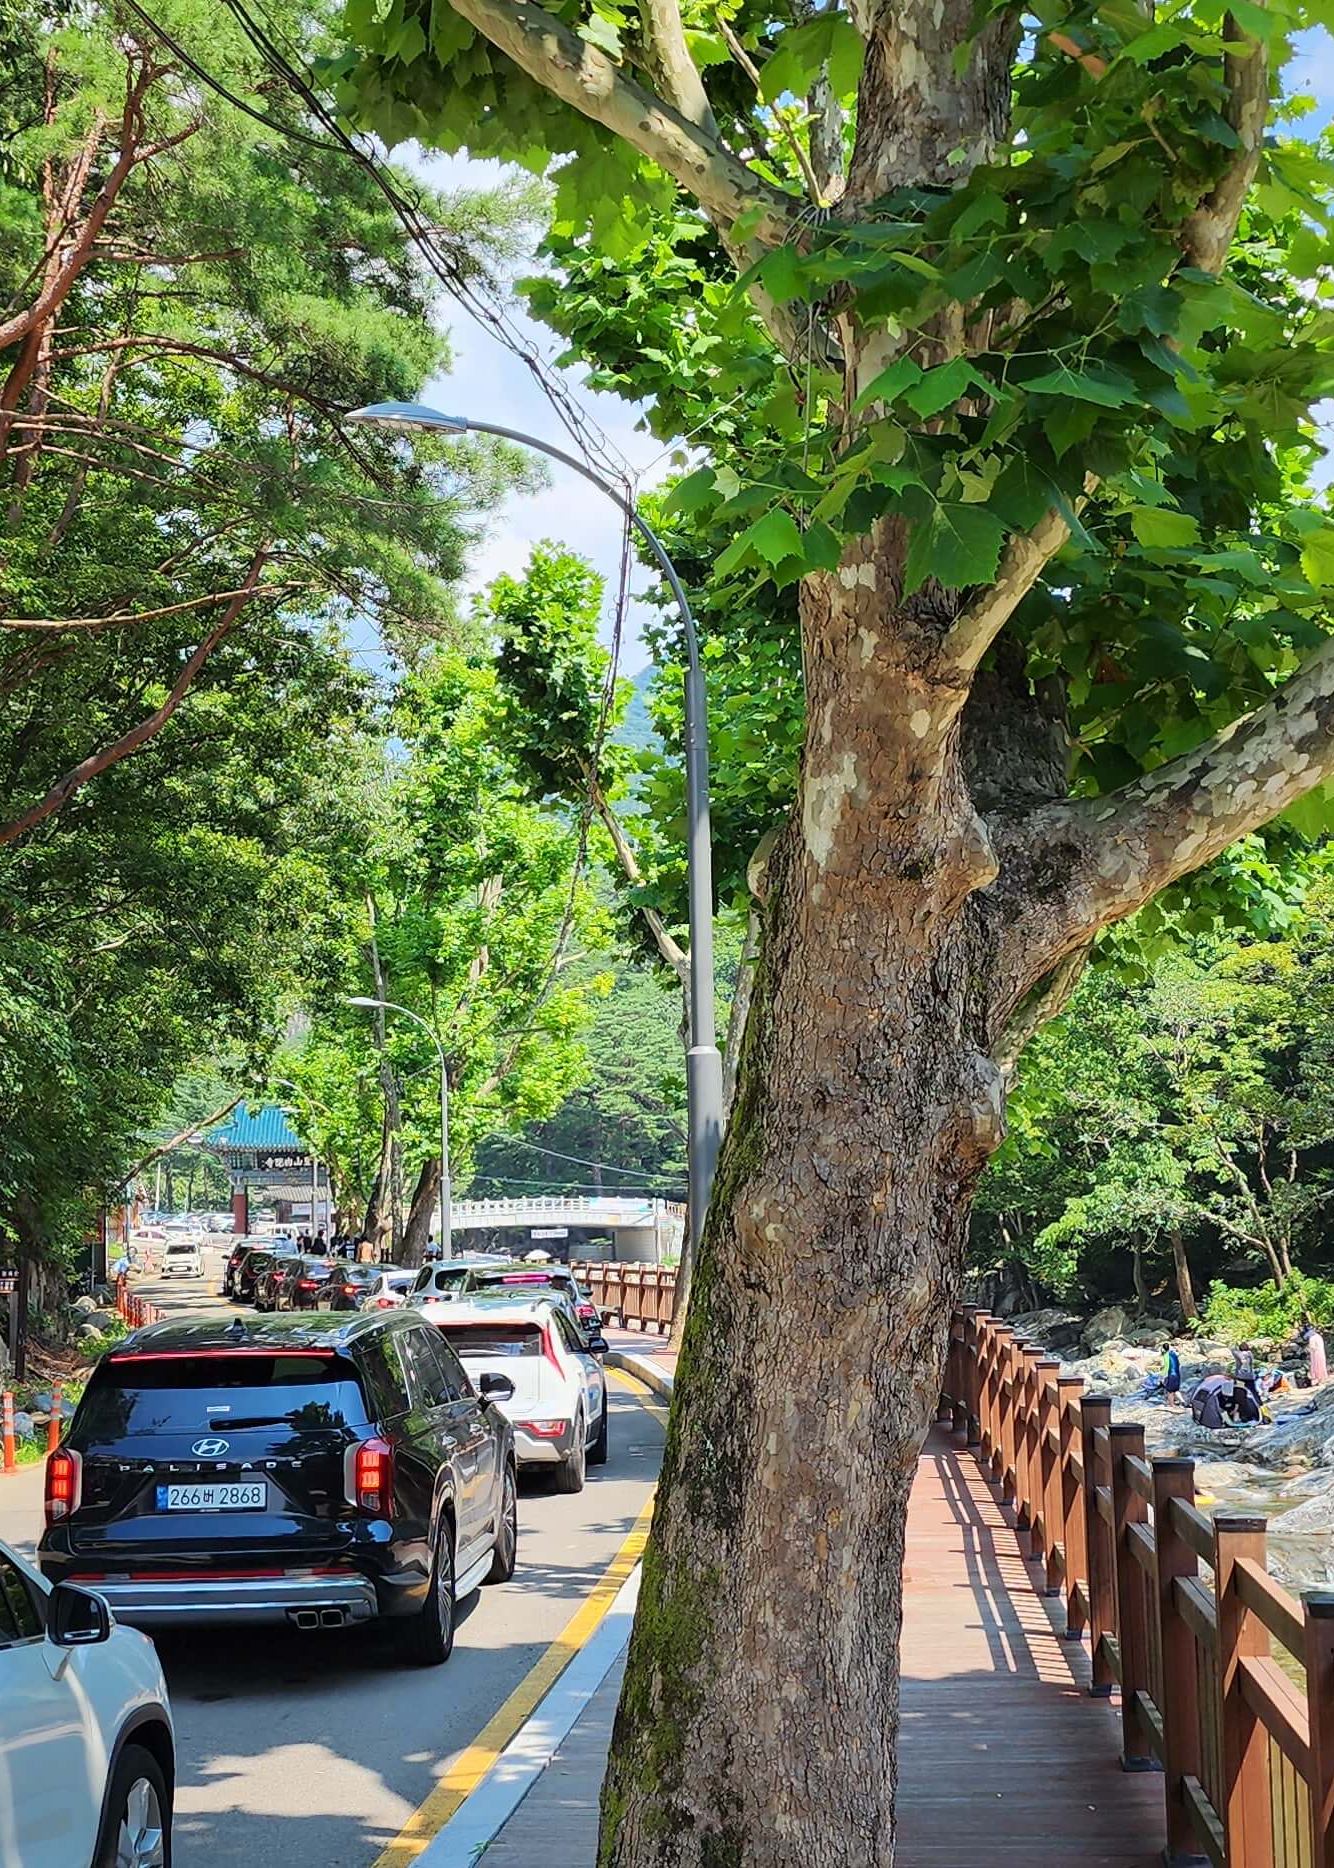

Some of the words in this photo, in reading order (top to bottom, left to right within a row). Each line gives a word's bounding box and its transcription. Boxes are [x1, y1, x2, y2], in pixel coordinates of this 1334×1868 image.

[119, 1461, 302, 1473] PALISADE
[170, 1488, 214, 1506] 266버
[219, 1486, 261, 1505] 2868
